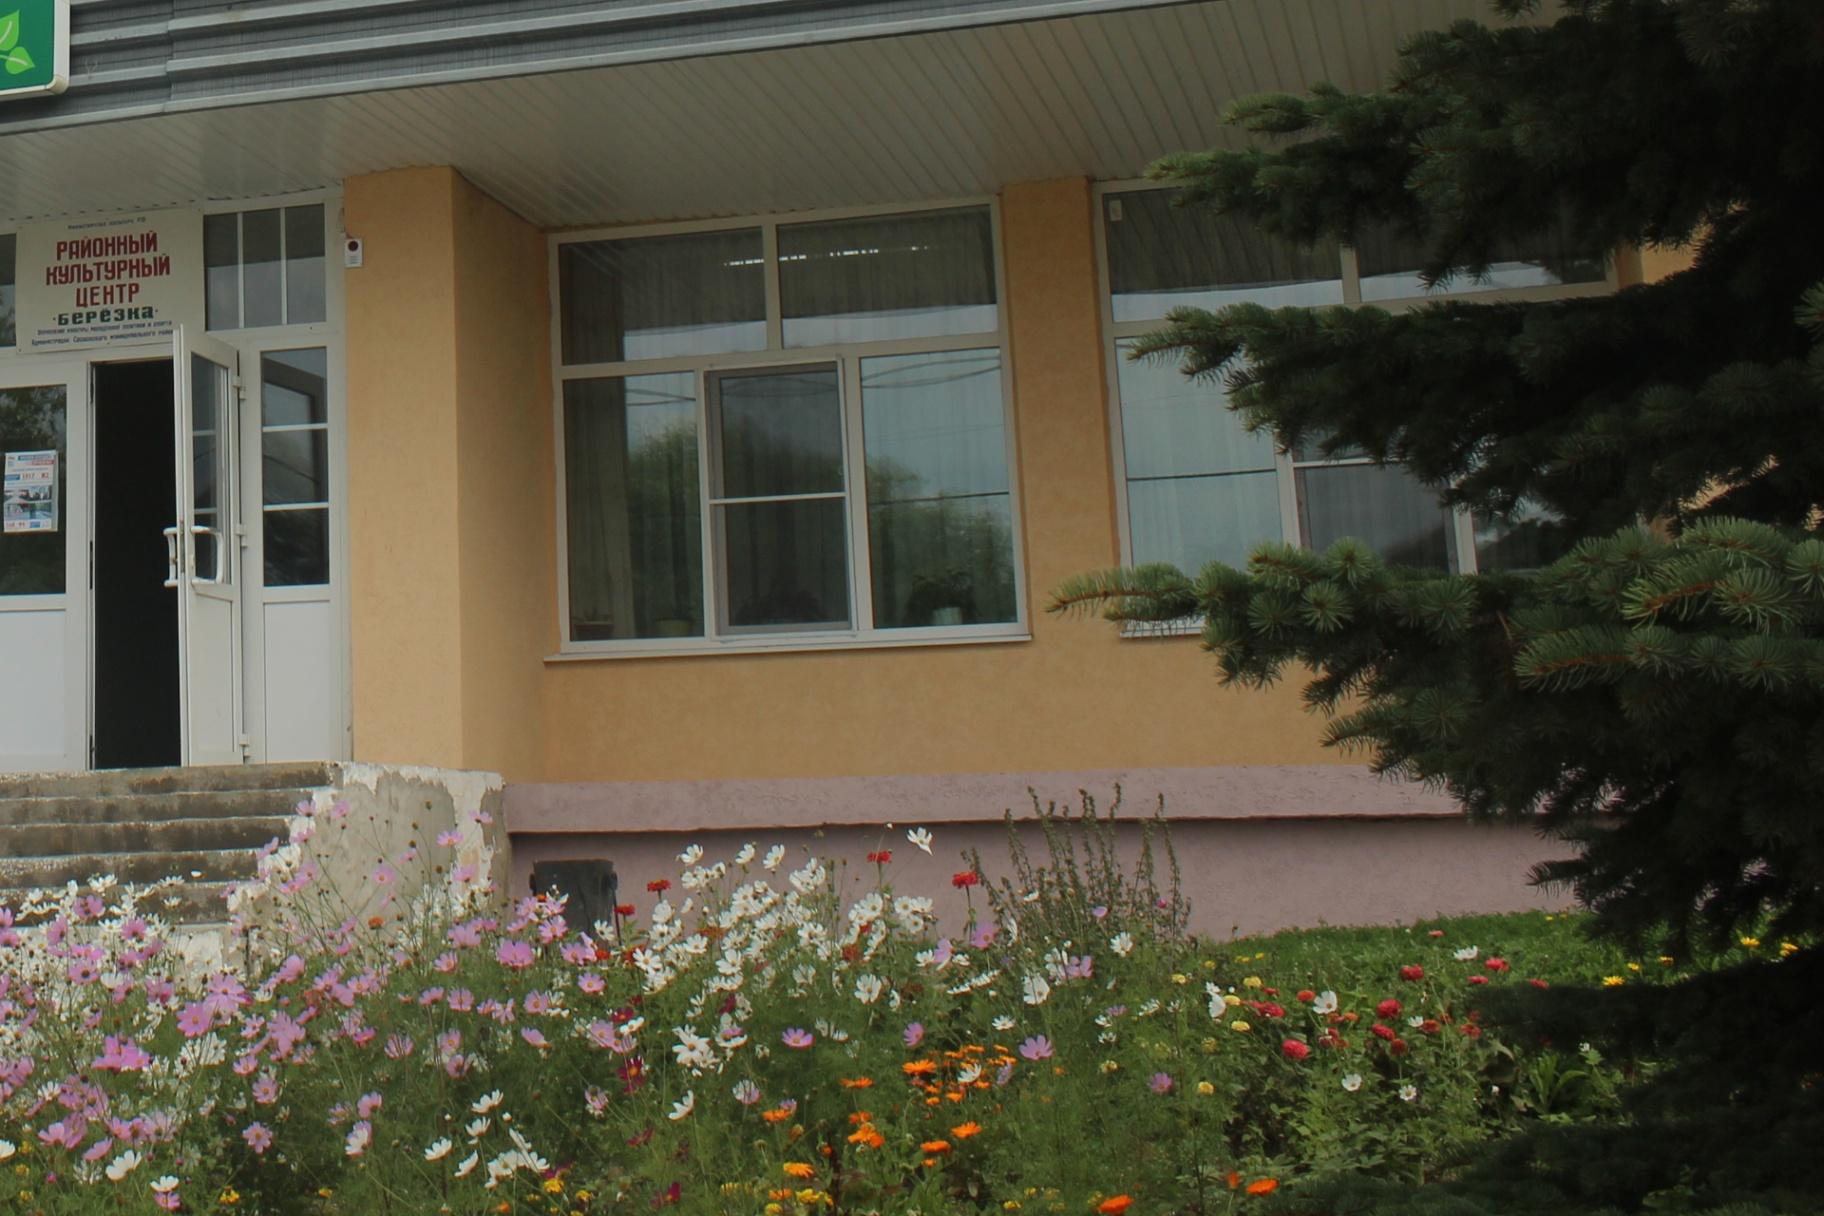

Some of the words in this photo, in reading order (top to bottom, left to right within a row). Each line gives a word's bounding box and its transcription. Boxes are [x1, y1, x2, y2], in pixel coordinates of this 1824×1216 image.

[56, 230, 158, 261] РАЙОННЫЙ
[46, 254, 170, 285] КУЛЬТУРНЫЙ
[76, 283, 140, 308] ЦЕНТР
